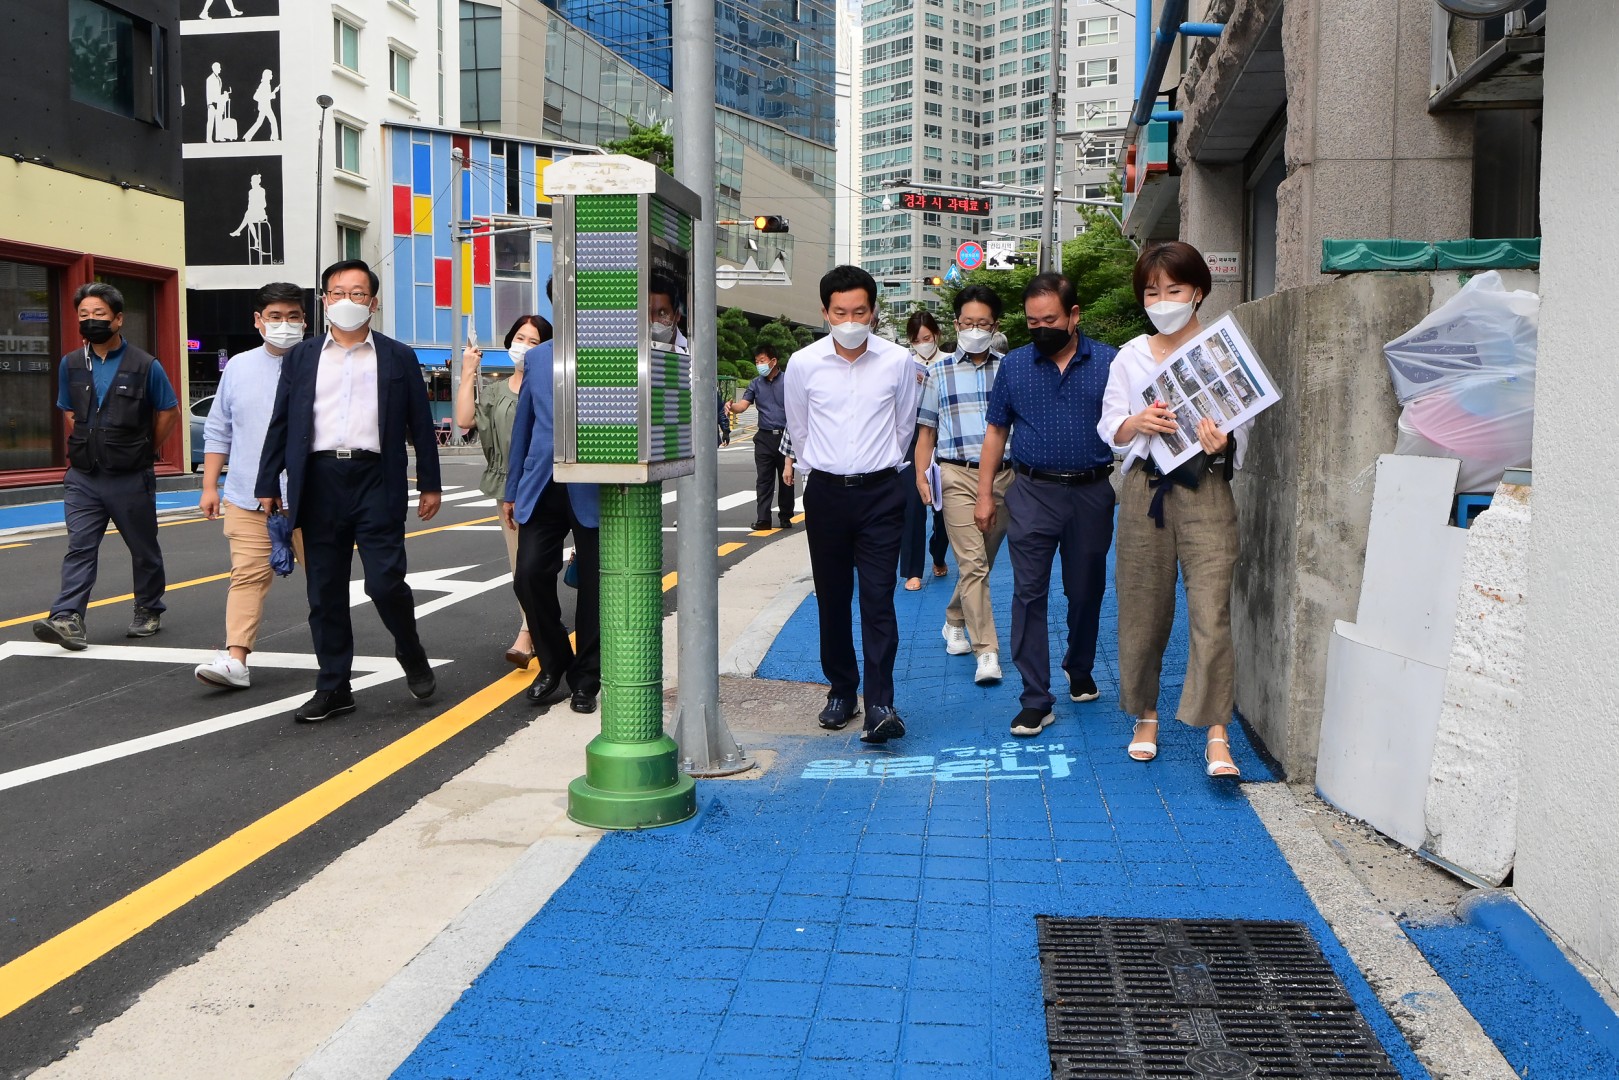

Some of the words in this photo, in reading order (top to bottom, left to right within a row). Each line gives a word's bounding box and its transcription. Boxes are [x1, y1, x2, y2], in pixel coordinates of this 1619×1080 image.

[904, 194, 926, 208] 경과
[931, 196, 942, 210] 시
[948, 198, 979, 212] 과태료
